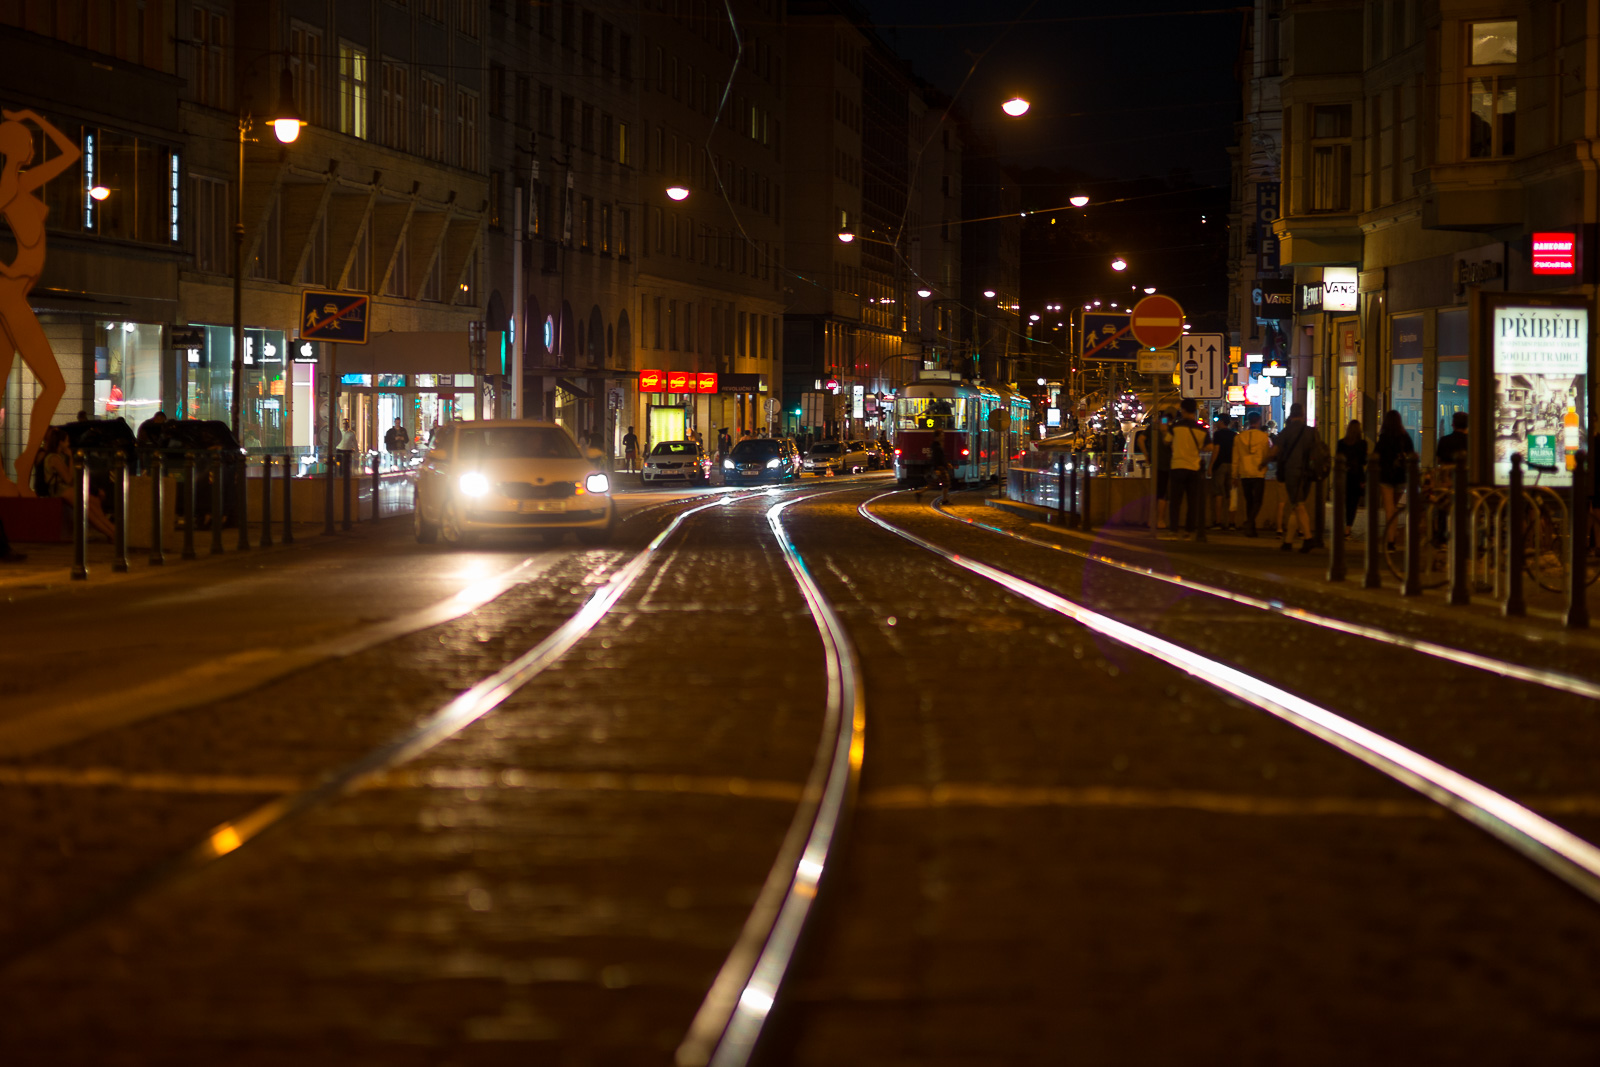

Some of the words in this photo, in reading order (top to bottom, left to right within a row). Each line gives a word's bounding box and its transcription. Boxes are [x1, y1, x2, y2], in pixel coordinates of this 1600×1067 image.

[1260, 191, 1277, 270] HOTEL
[1533, 242, 1573, 251] BANKOMAT
[1323, 281, 1356, 294] VANS
[1264, 293, 1293, 304] VANS
[1501, 312, 1581, 339] PŘÍBĚH
[1501, 352, 1519, 362] 500
[1521, 352, 1539, 362] LET
[1540, 352, 1579, 362] TRADICE
